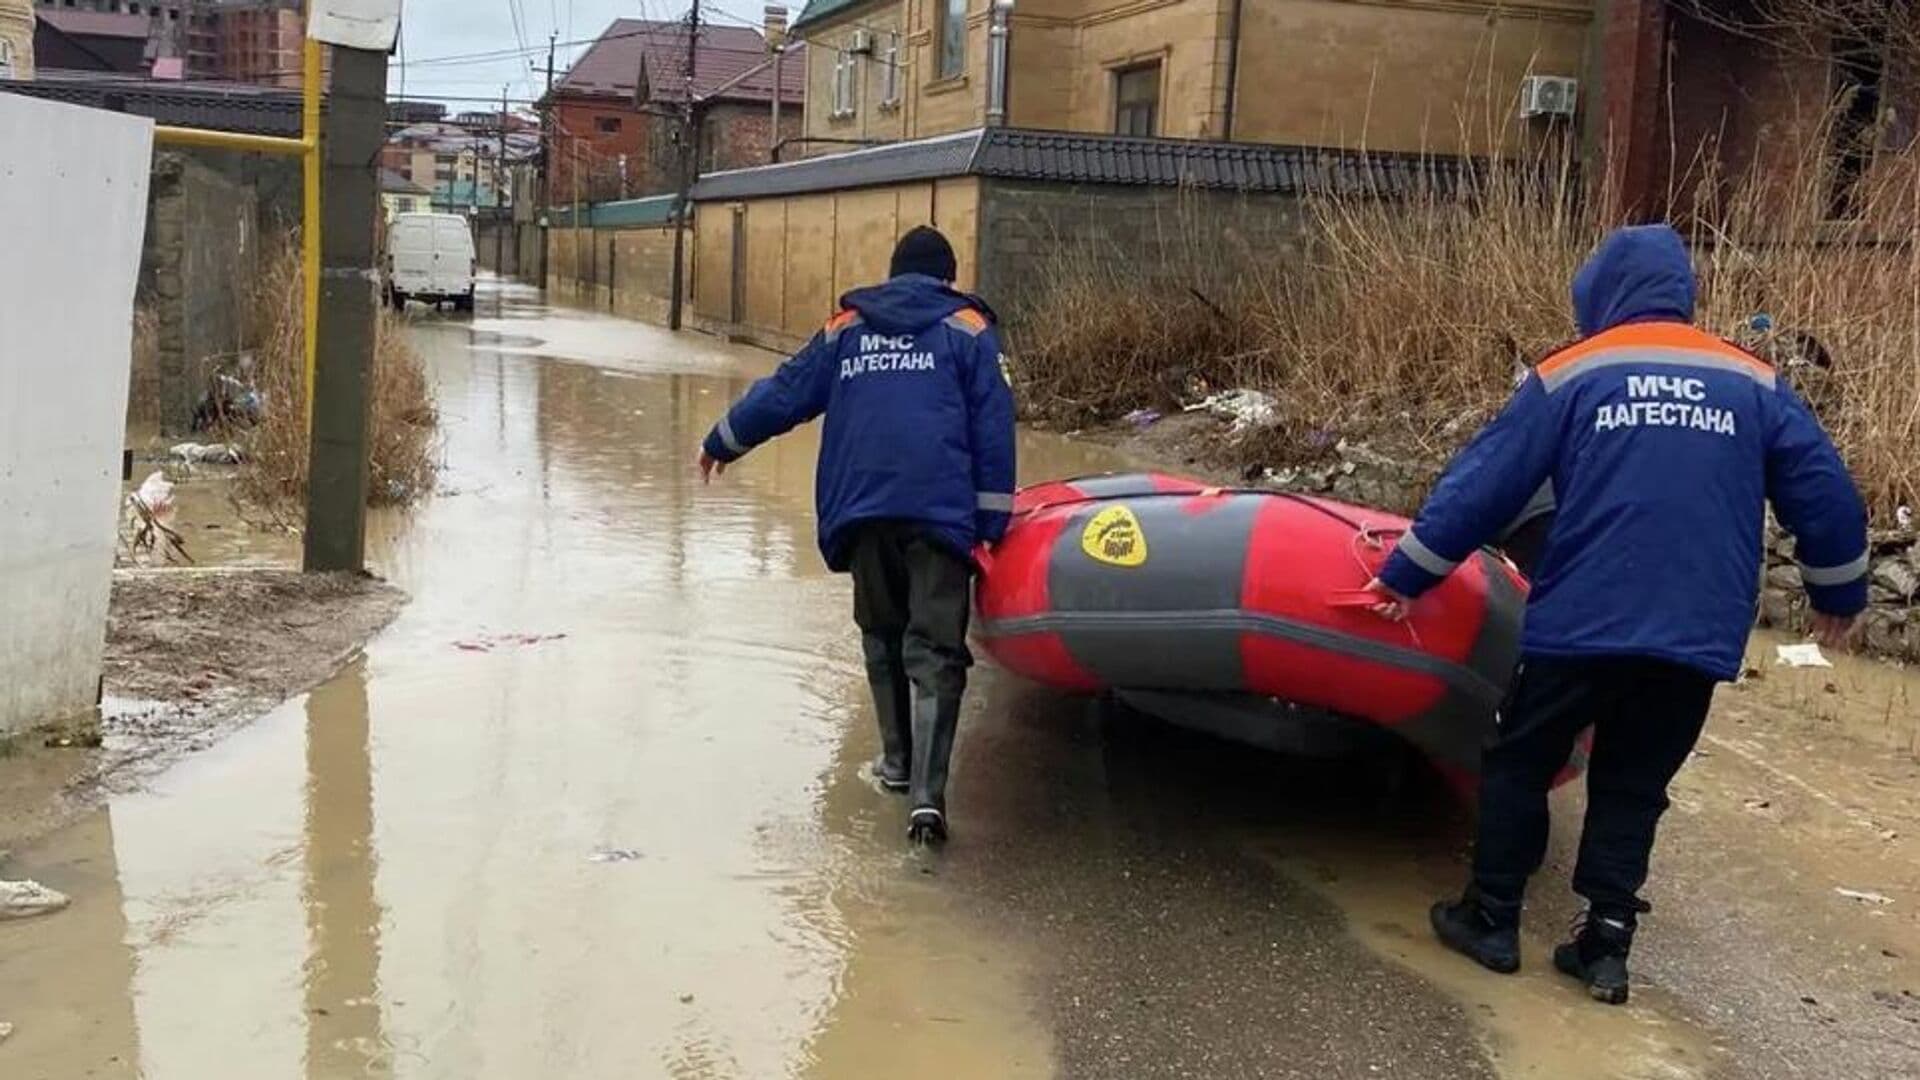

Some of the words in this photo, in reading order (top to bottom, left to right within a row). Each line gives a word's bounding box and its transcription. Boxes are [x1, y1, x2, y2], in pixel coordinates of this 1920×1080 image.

[861, 335, 913, 353] МЧС
[841, 353, 935, 379] ДАГЕСТАНА
[1627, 375, 1706, 401] МЧС
[1595, 402, 1736, 436] ДАГЕСТАНА
